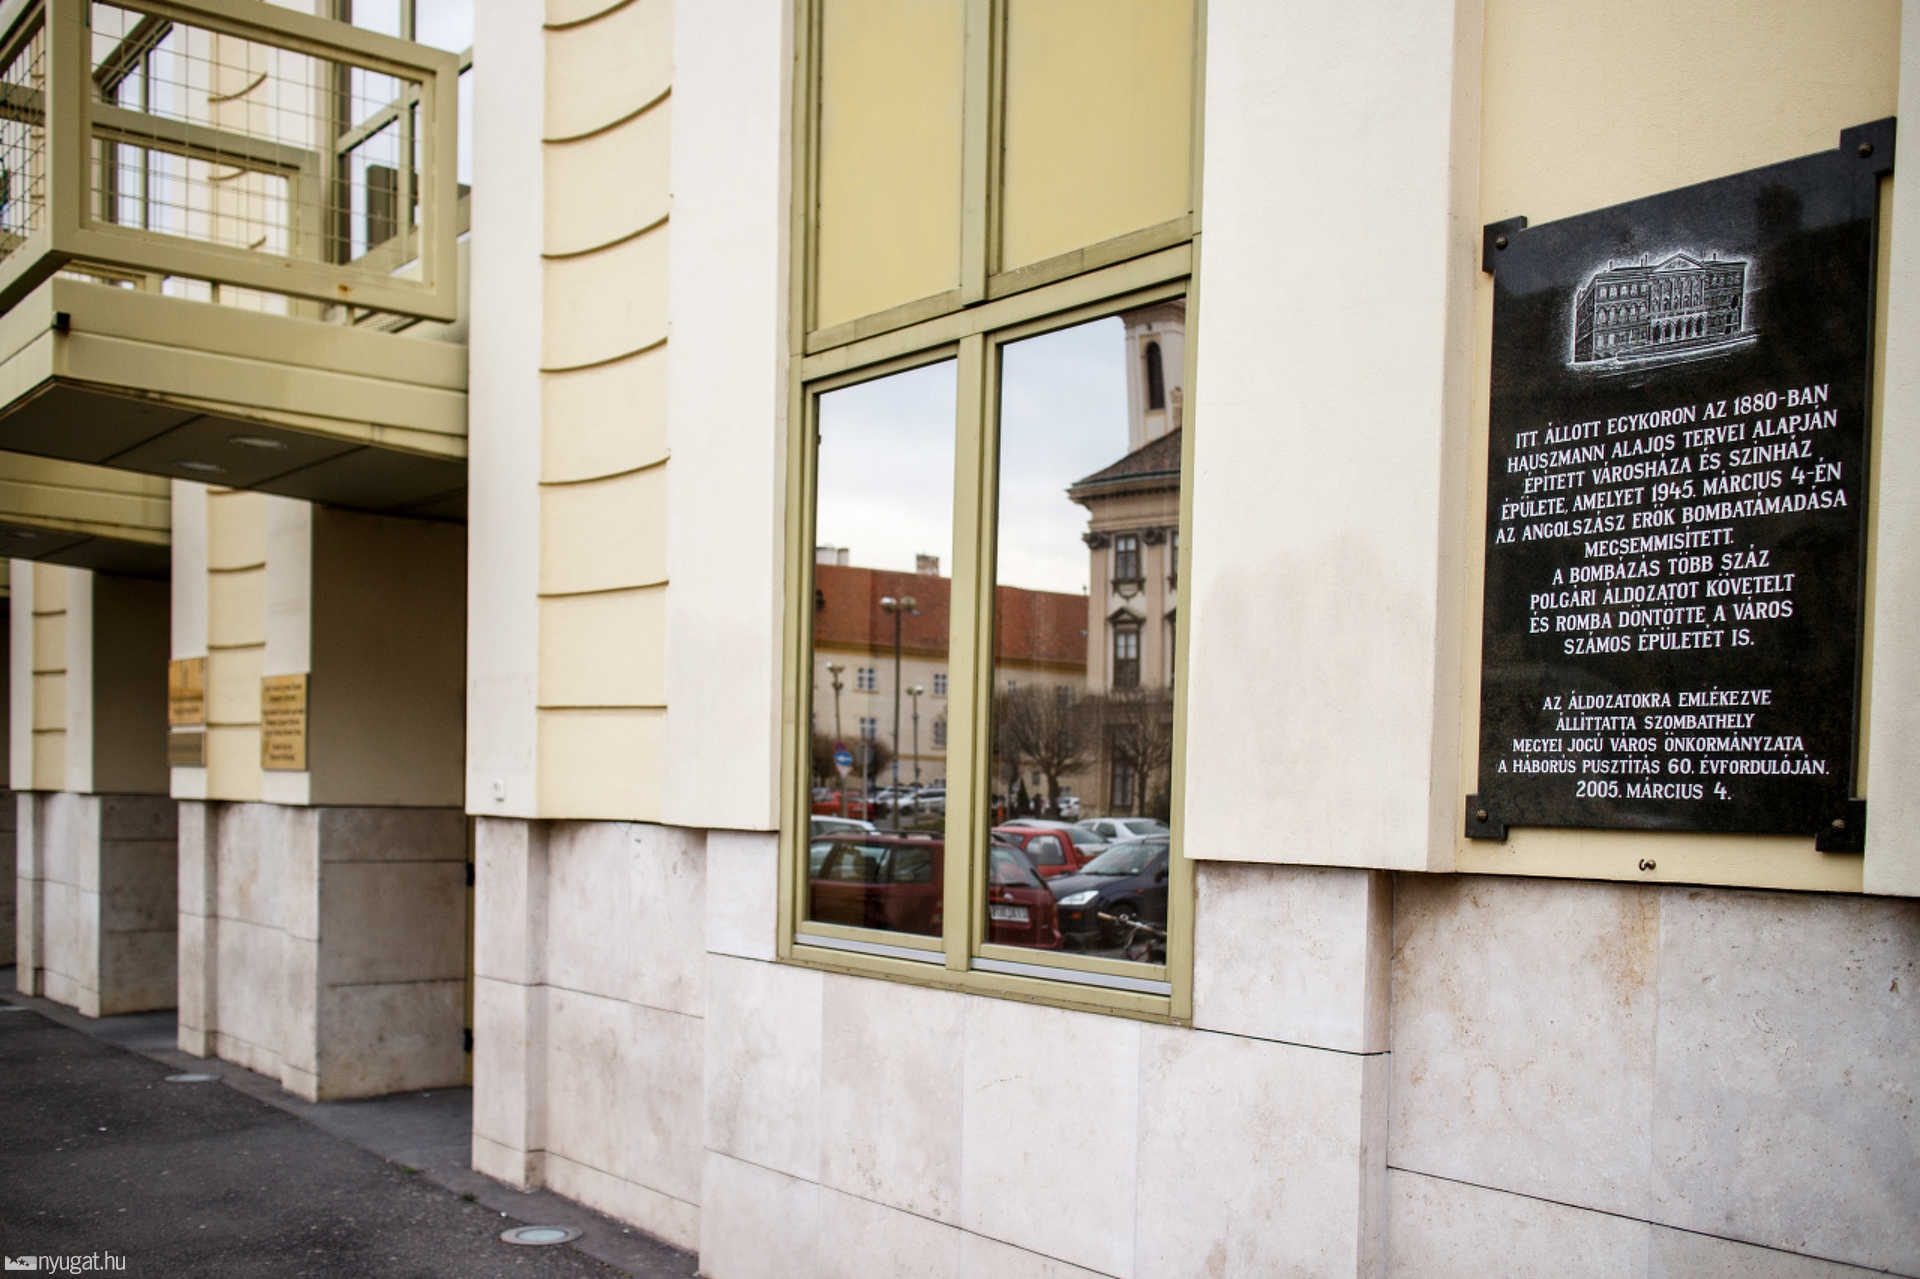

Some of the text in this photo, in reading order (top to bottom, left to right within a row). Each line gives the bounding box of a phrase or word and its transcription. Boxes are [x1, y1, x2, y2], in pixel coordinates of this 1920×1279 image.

[1515, 384, 1829, 449] ITT ÁLLOTT EGYKORON AZ 1880-BAN
[1507, 404, 1839, 474] HAUSZMANN ALAJOS TERVEI ALAPJÁN
[1522, 434, 1812, 495] ÉPÍTETT VÁROSHÁZA ÉS SZÍNHÁZ
[1501, 456, 1843, 521] ÉPÜLETE, AMELYET 1945. MÁRCIUS 4-ÉN
[1495, 526, 1516, 544] AZ
[1521, 511, 1626, 541] ANGOLSZÁSZ
[1681, 484, 1848, 524] BOMBATÁMADÁSA
[1583, 525, 1734, 559] MEGSEMMISÍTETT.
[1552, 543, 1770, 585] A BOMBÁZÁS TÖBB SZÁZ
[1530, 573, 1795, 610] POLGÁRI ÁLDOZATOT KÖVETELT
[1529, 595, 1794, 633] ÉS ROMBA DÖNTÖTTE A VÁROS
[1563, 623, 1755, 655] SZÁMOS ÉPÜLETÉT IS.
[1542, 686, 1772, 711] AZ ÁLDOZATOKRA EMLÉKEZVE
[1555, 711, 1755, 731] ÁLLÍTTATTA SZOMBATHELY
[1512, 731, 1804, 752] MEGYEI JOGÚ VÁROS ÖNKORMÁNYZATA
[1497, 753, 1829, 775] A HÁBORÚS PUSZTÍTÁS 60. ÉVFORDULÓJÁN.
[1576, 777, 1732, 800] 2005. MÁRCIUS 4.
